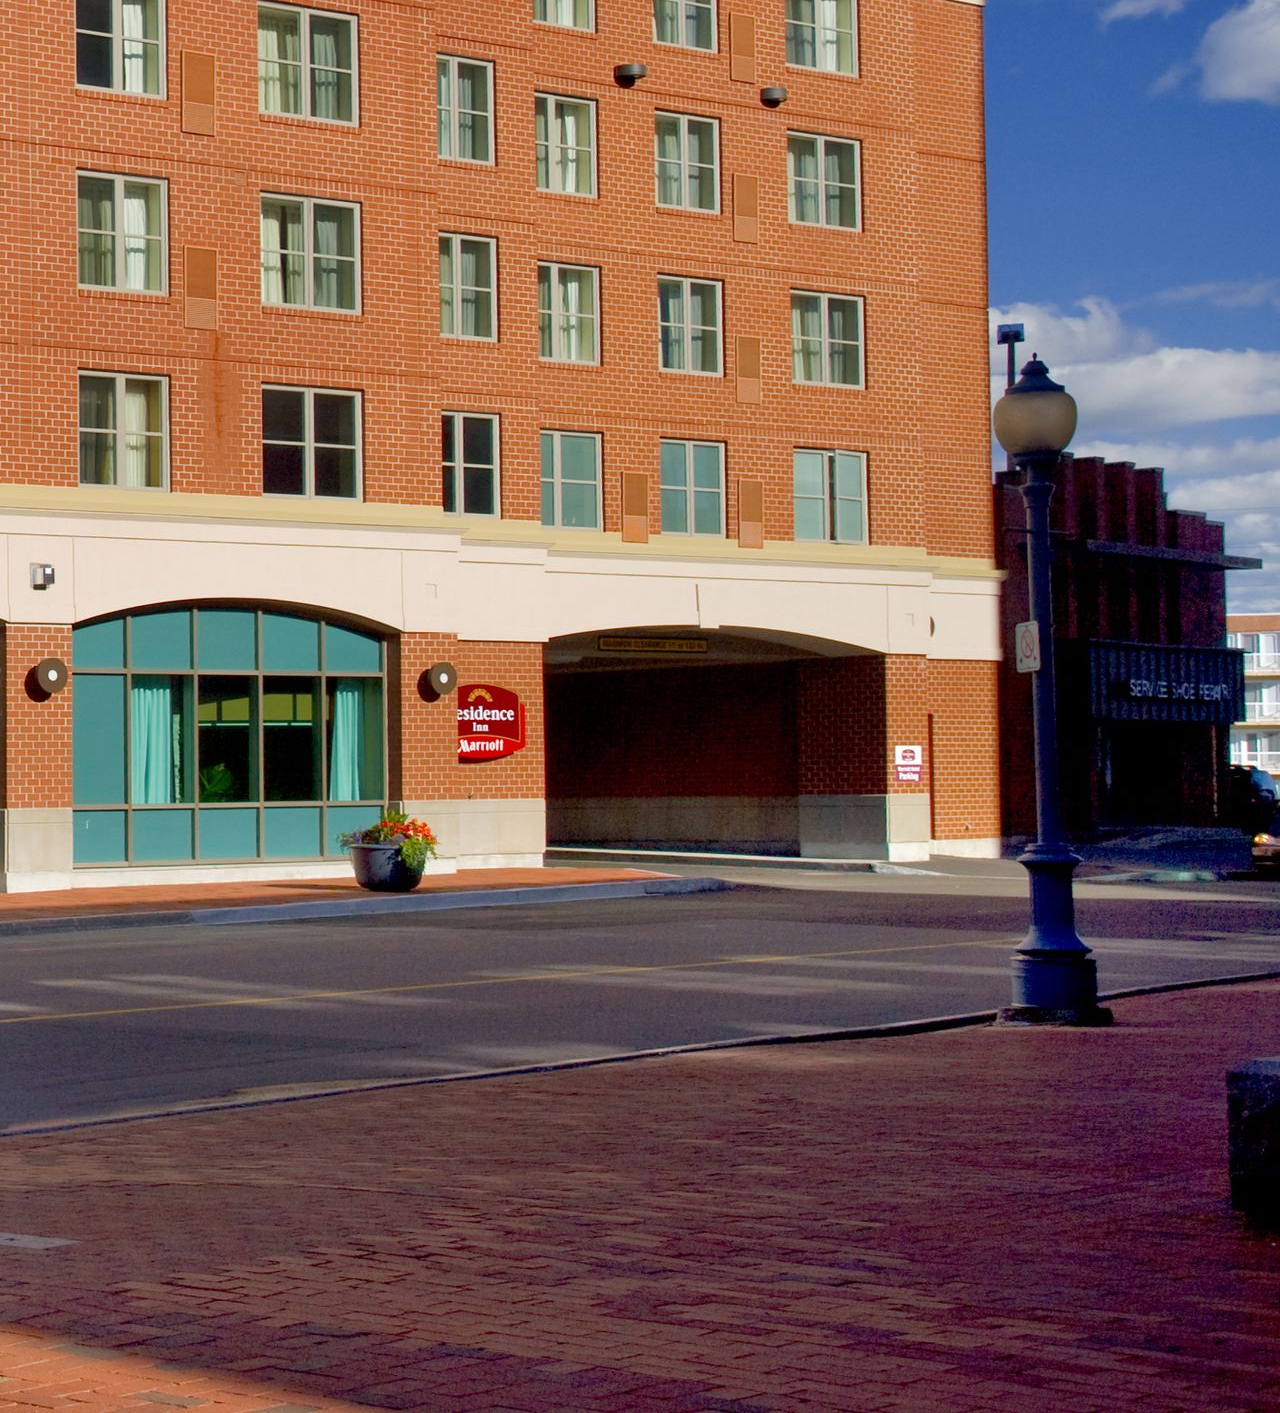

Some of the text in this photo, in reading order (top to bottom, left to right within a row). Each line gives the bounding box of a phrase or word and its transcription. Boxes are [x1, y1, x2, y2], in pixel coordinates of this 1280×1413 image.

[457, 706, 514, 720] esidence
[473, 722, 488, 731] Inn
[457, 739, 504, 753] Marriott
